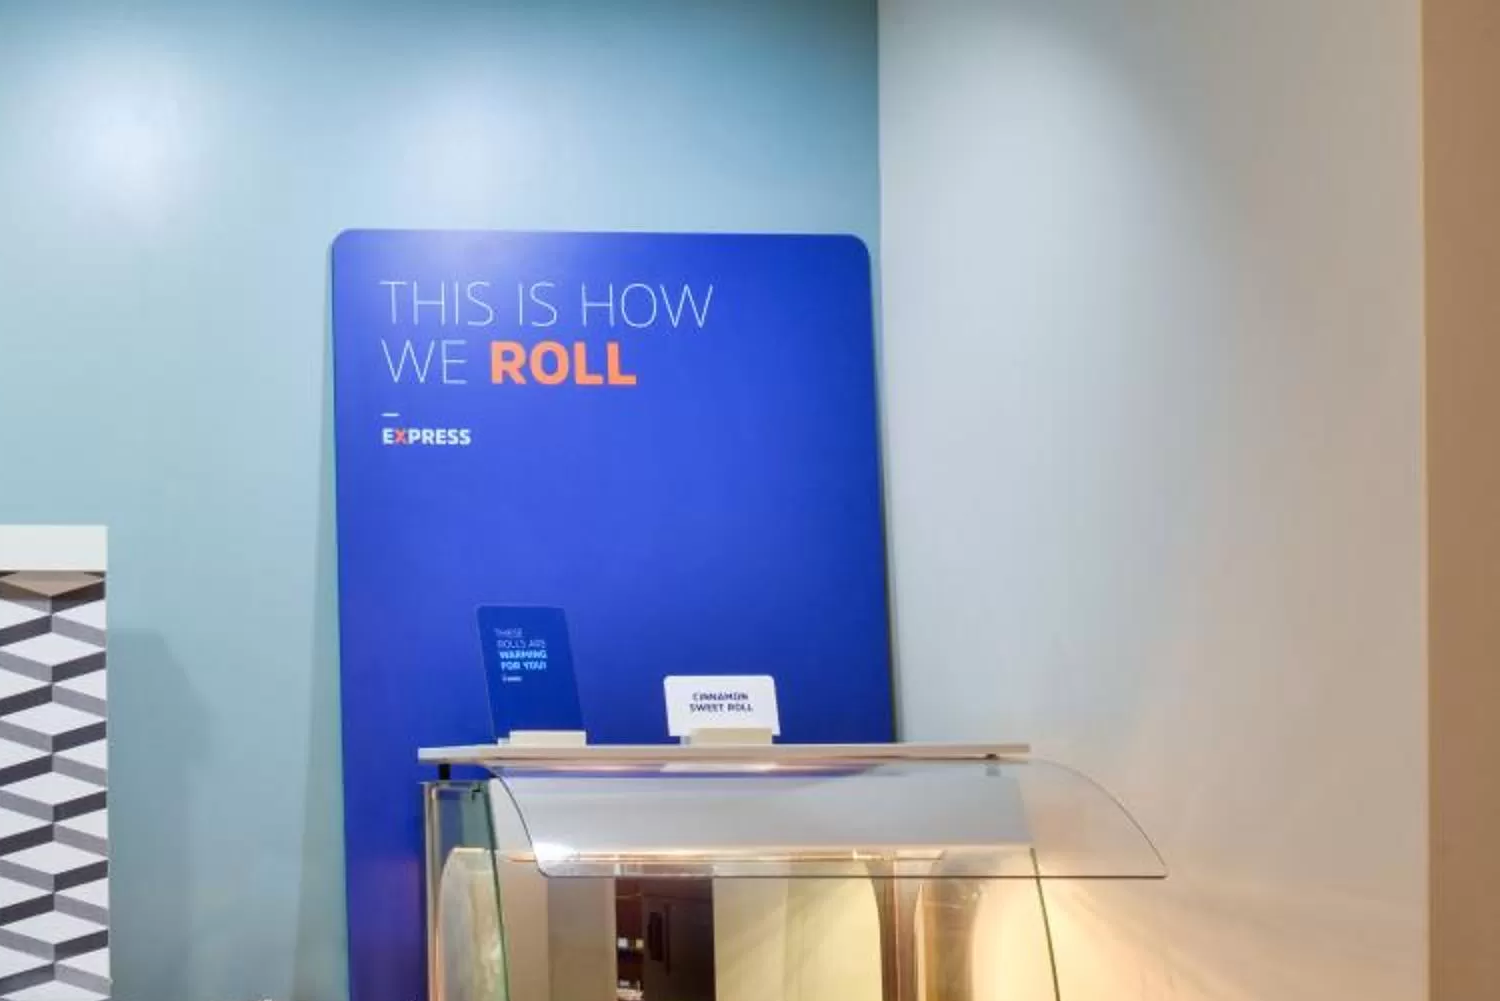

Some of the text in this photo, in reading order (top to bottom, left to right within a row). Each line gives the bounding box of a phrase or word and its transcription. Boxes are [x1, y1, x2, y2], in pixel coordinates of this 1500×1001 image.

[380, 280, 714, 329] THIS IS HOW
[380, 338, 637, 386] WE ROLL
[381, 426, 472, 447] EXPRESS
[499, 650, 548, 659] WARMING
[500, 661, 521, 671] FOR
[691, 691, 749, 701] CINNAMON
[689, 703, 754, 713] SWEET ROLL
